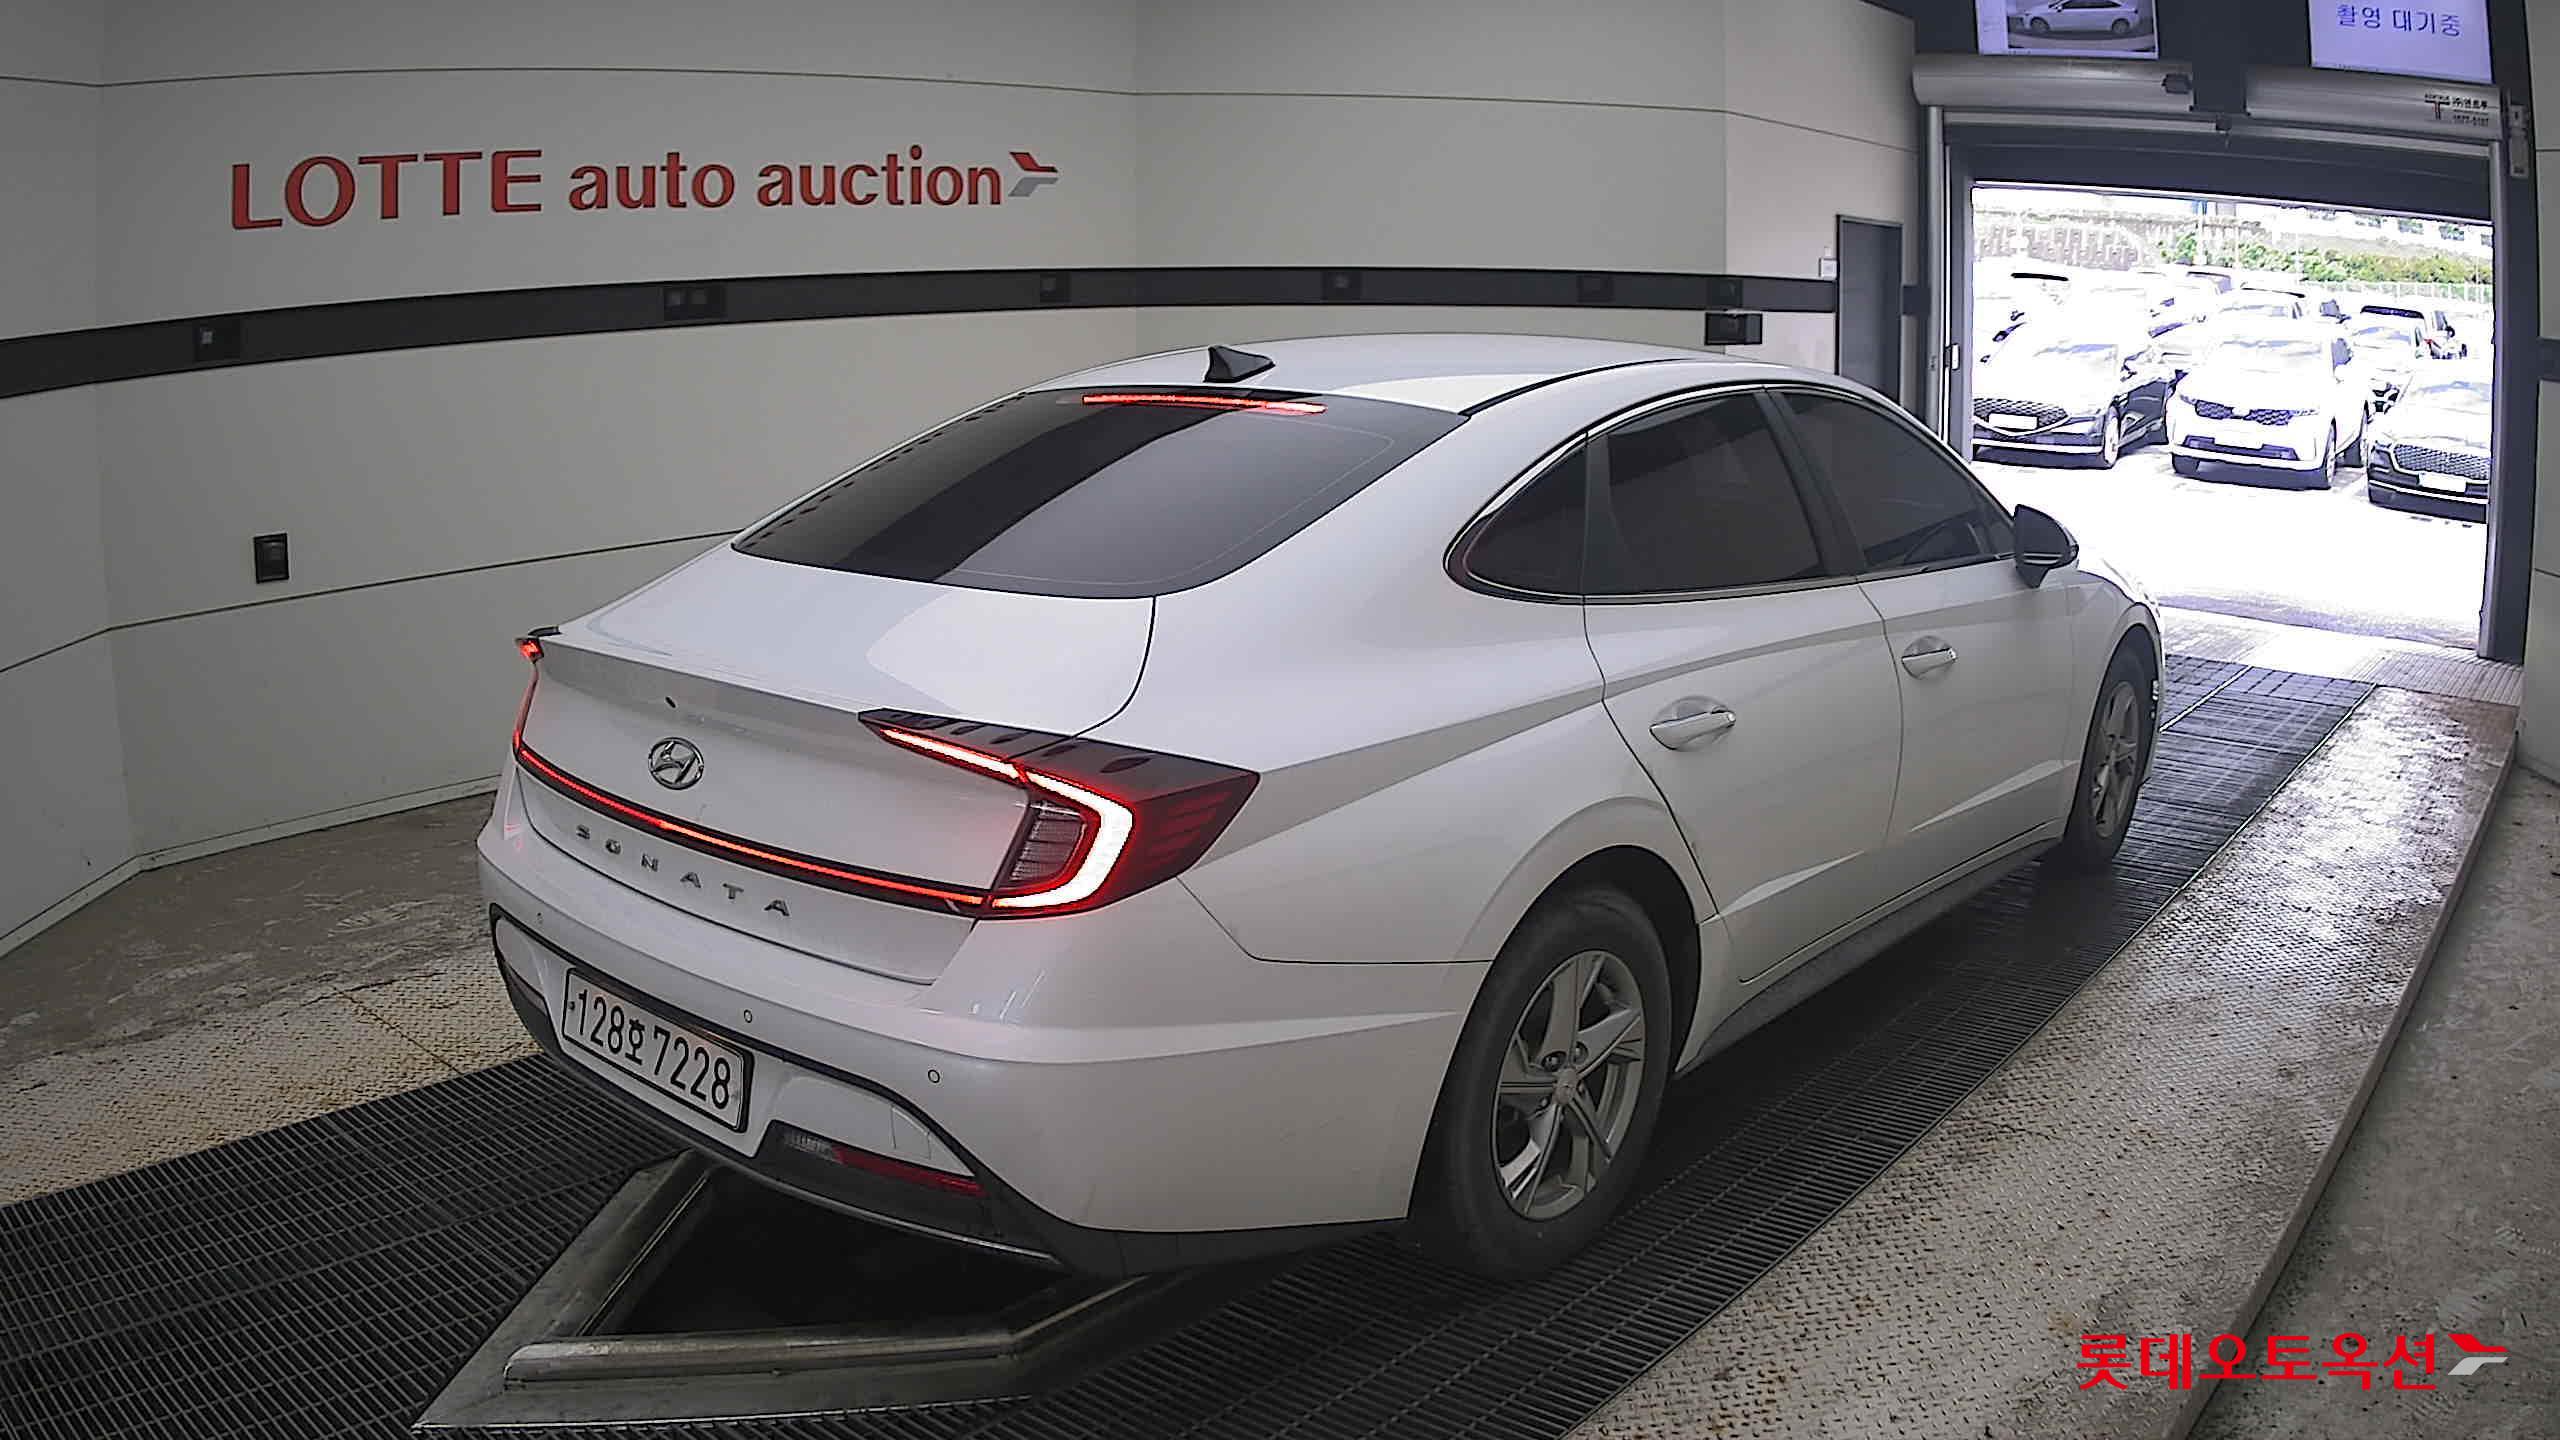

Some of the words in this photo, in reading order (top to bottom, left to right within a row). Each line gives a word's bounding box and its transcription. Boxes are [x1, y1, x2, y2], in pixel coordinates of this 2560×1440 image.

[2337, 4, 2381, 29] 촬영
[2392, 9, 2460, 37] 대기중
[231, 150, 543, 229] LOTTE
[569, 151, 734, 208] auto
[757, 146, 1002, 205] auction
[576, 824, 790, 917] SONATA
